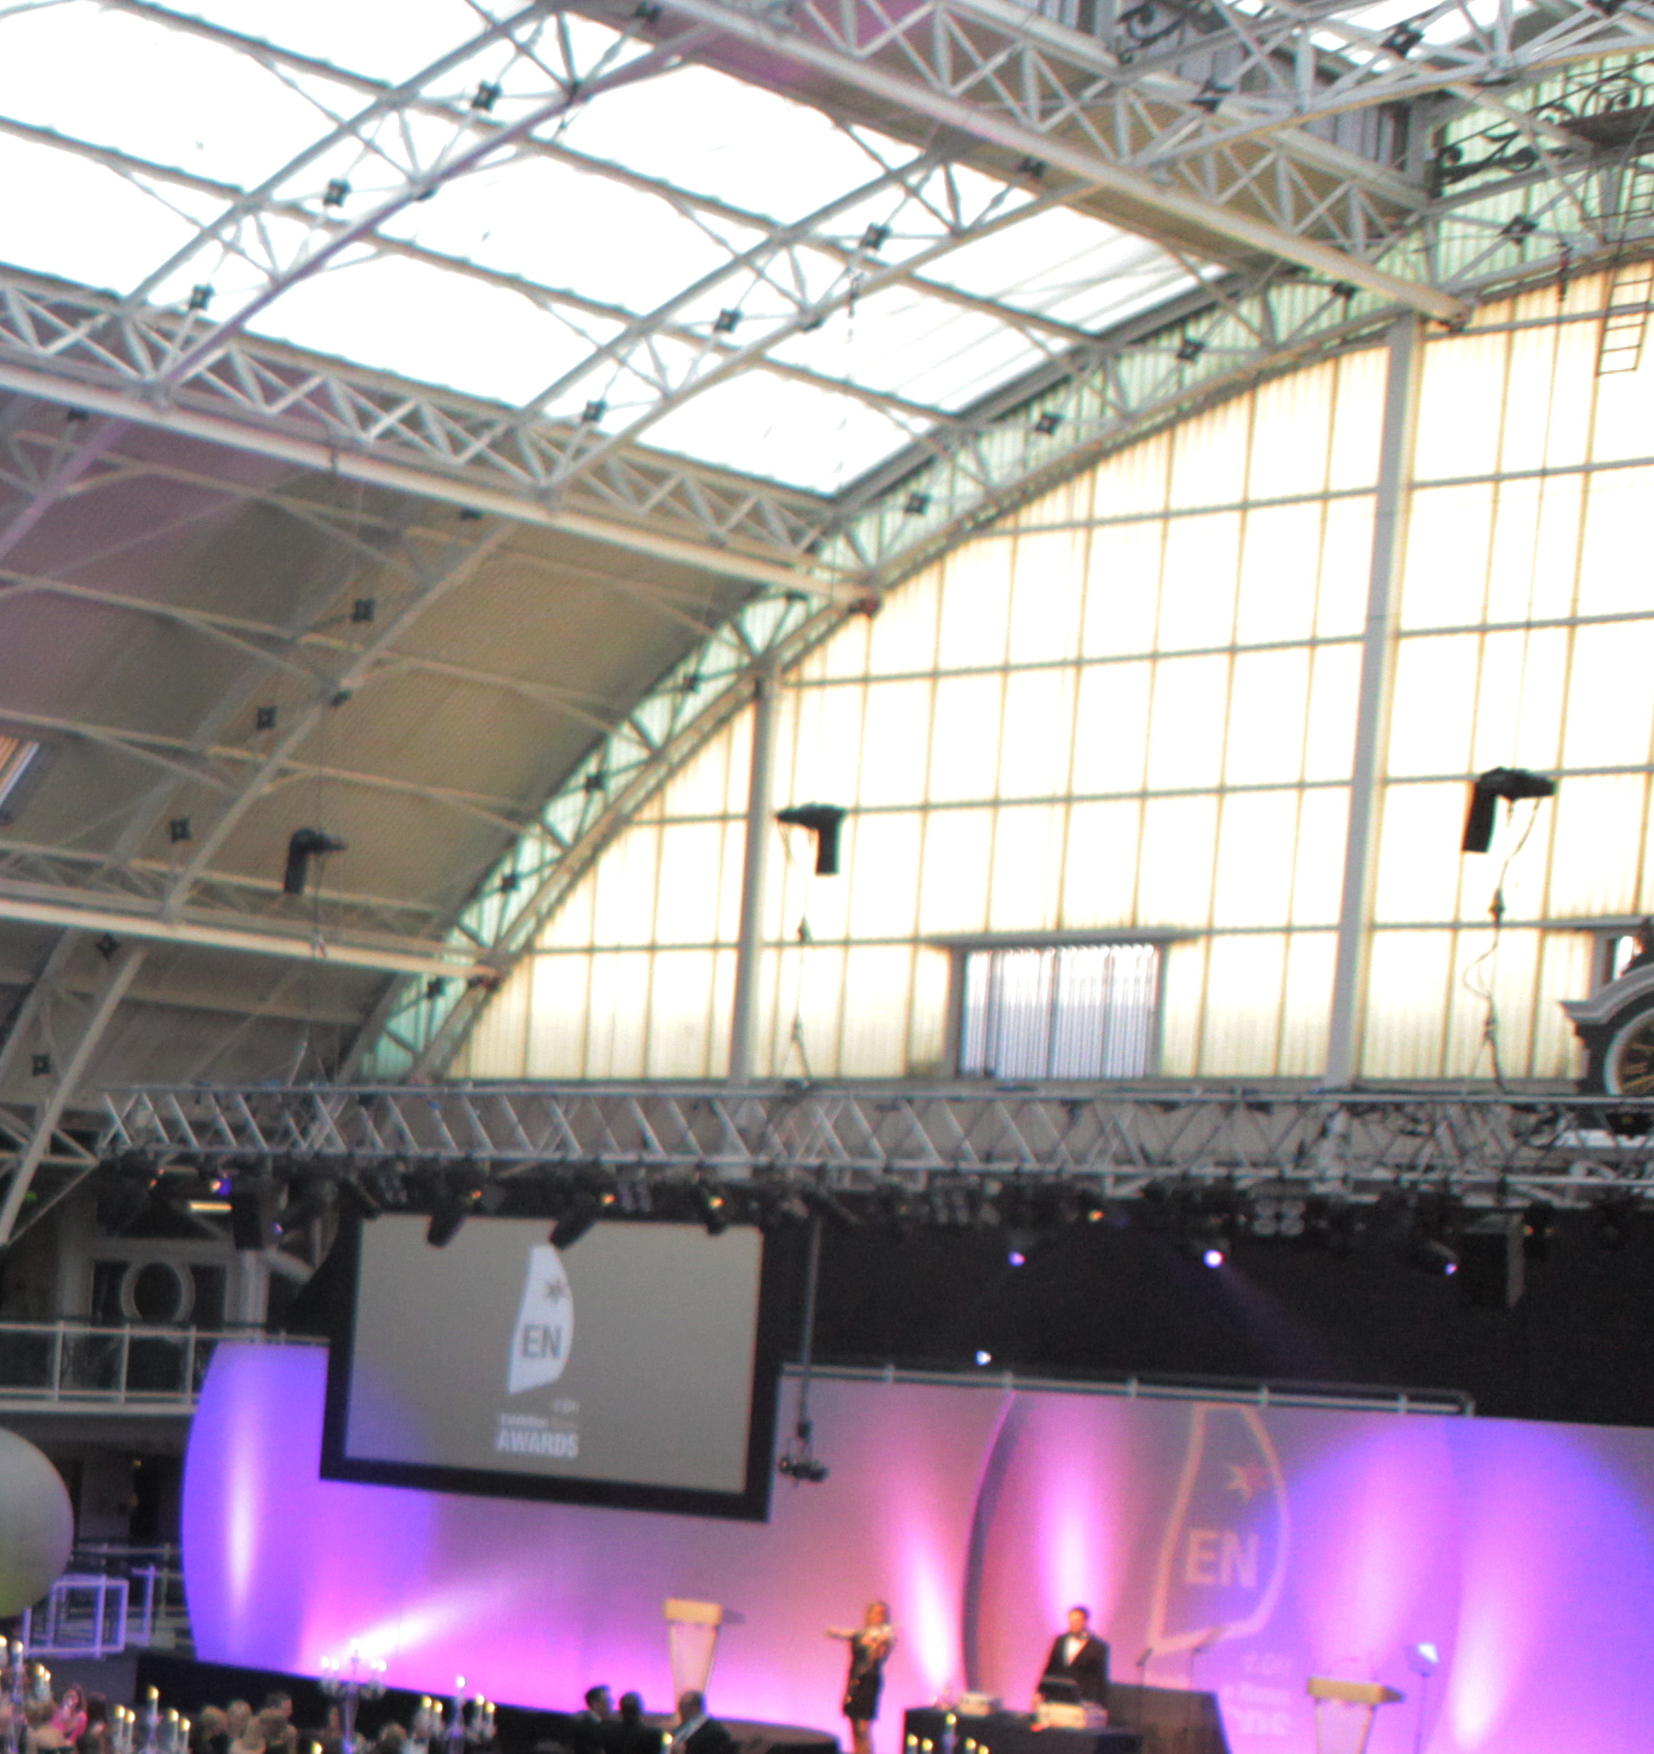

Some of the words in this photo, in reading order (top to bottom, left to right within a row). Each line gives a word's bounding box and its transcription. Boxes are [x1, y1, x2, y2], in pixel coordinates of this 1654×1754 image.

[522, 1323, 563, 1358] EN
[497, 1429, 579, 1458] AWARDS
[1186, 1529, 1260, 1588] EN
